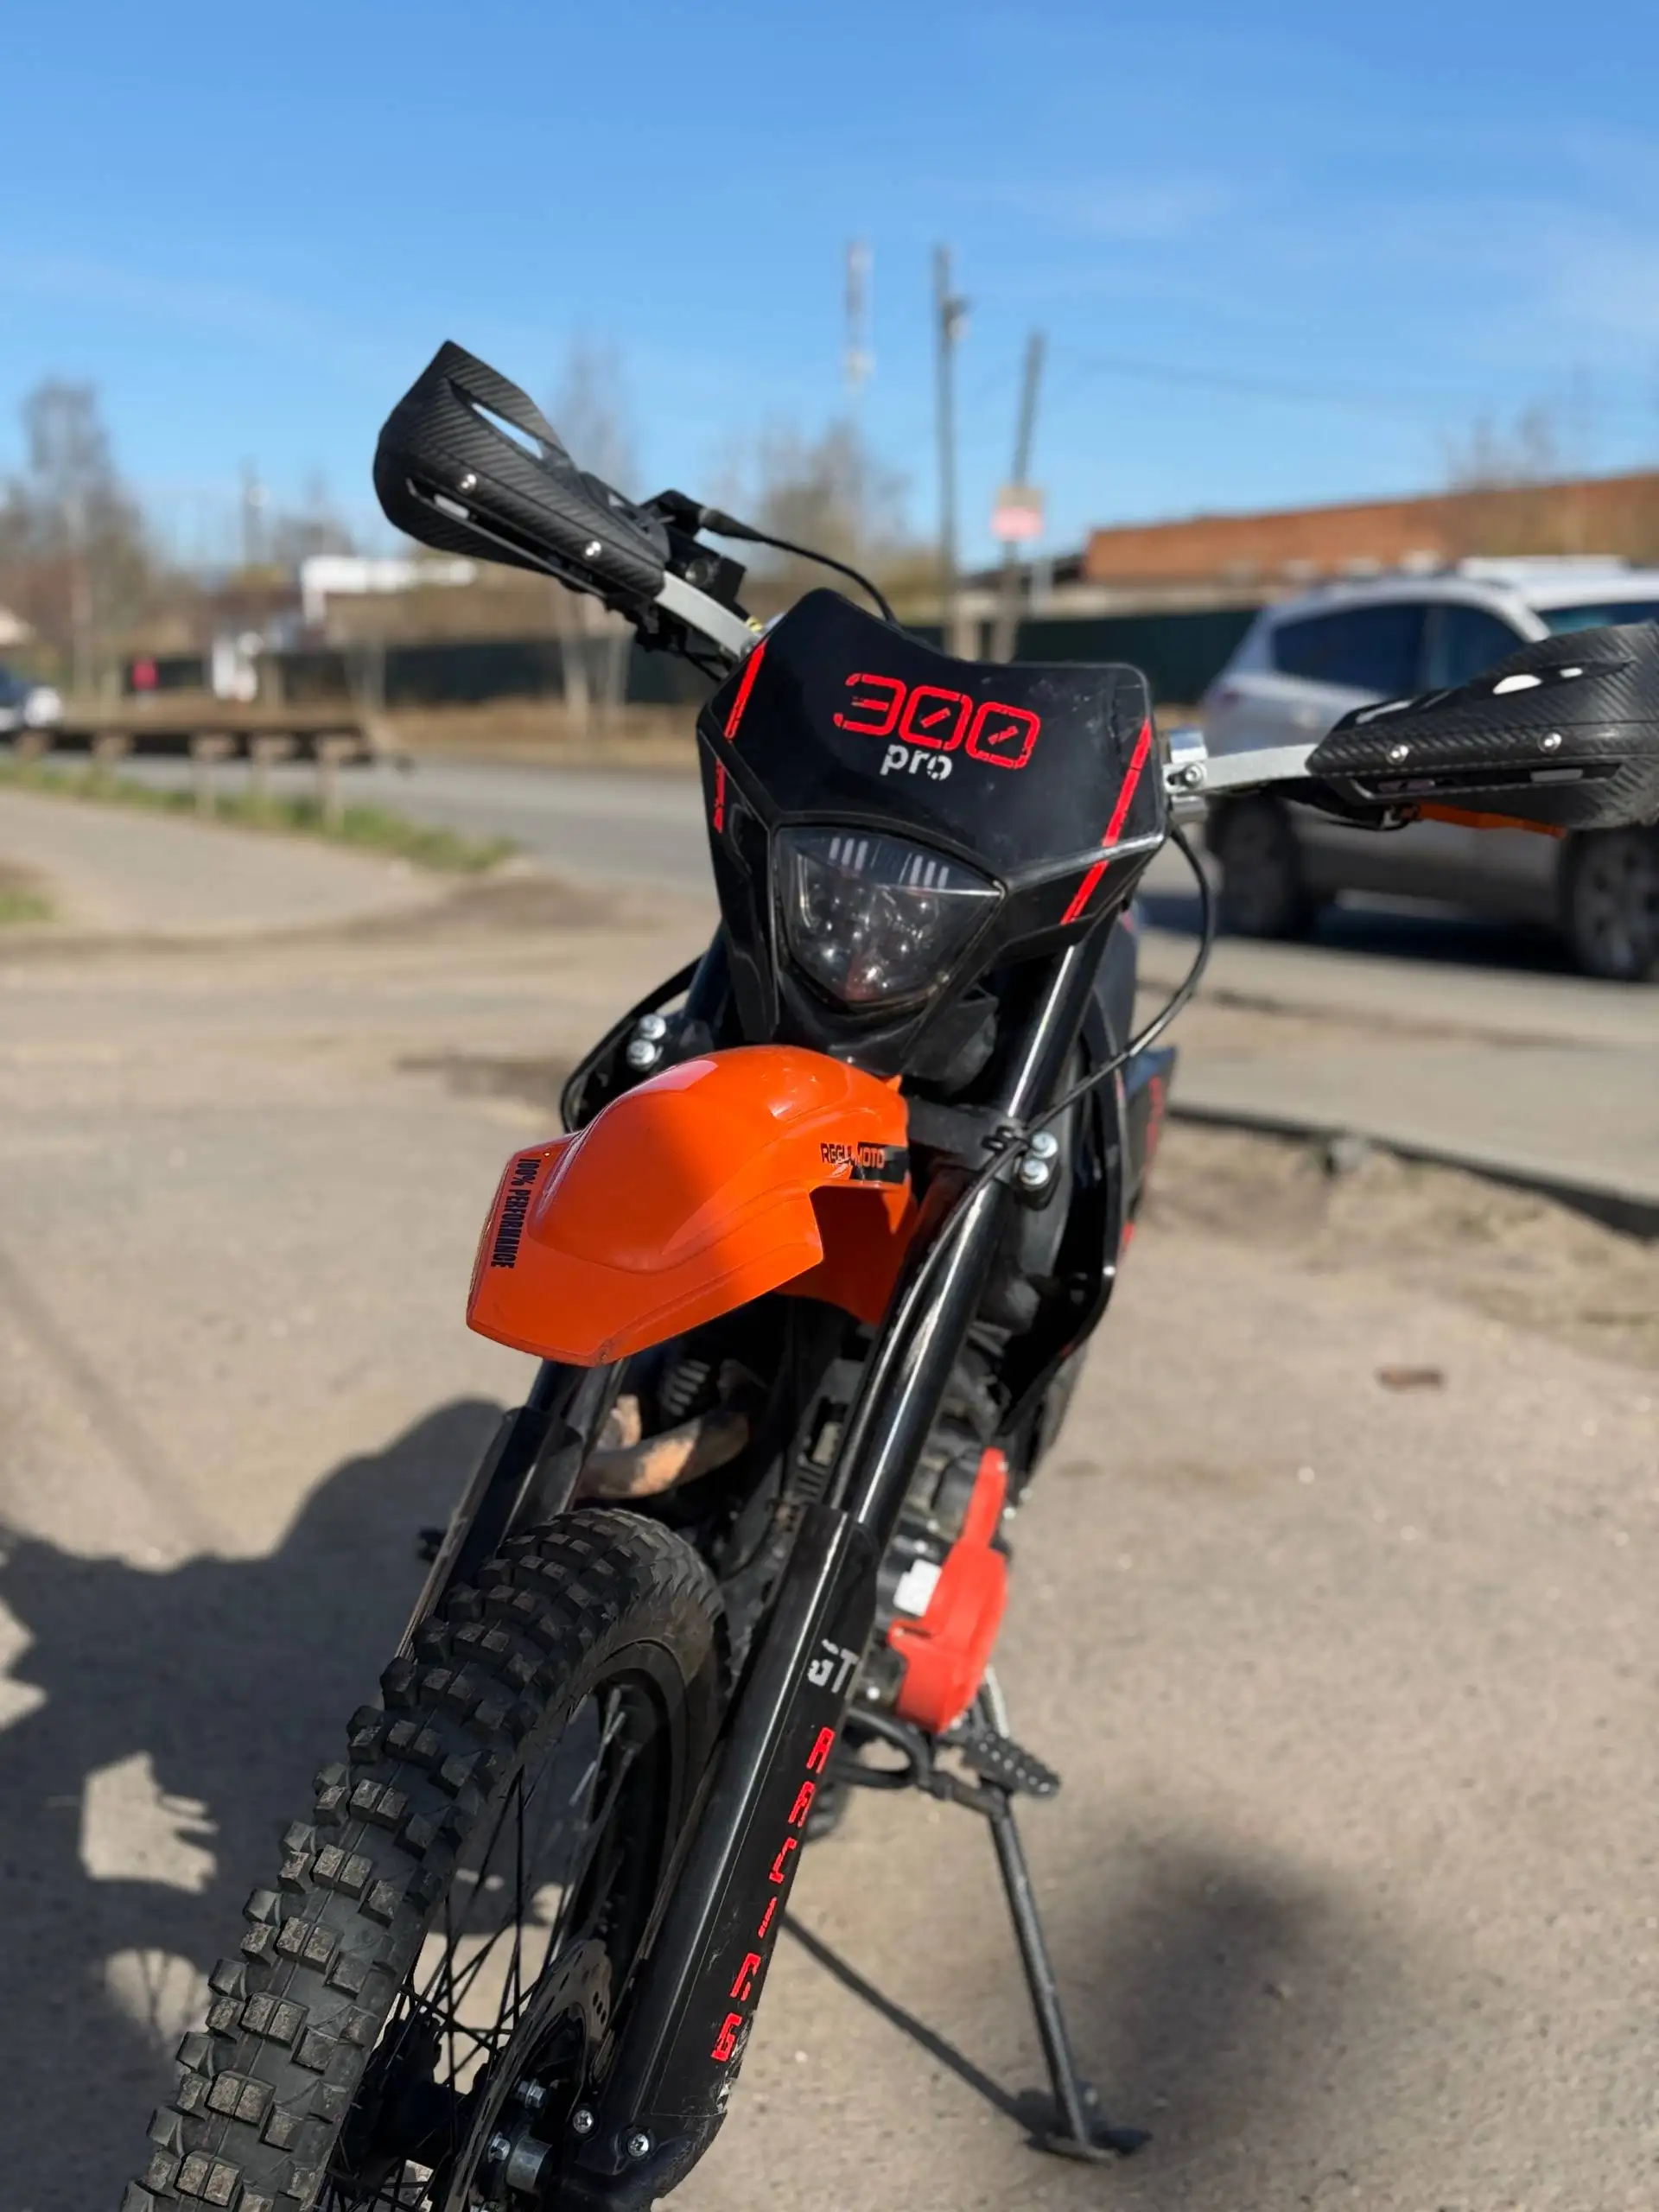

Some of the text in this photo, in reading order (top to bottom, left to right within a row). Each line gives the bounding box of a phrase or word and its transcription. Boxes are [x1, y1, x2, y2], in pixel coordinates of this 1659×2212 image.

[833, 673, 1040, 769] 300
[880, 744, 953, 780] pro
[490, 1158, 542, 1268] 100% PERFORMANCE
[712, 1726, 834, 2061] RACING
